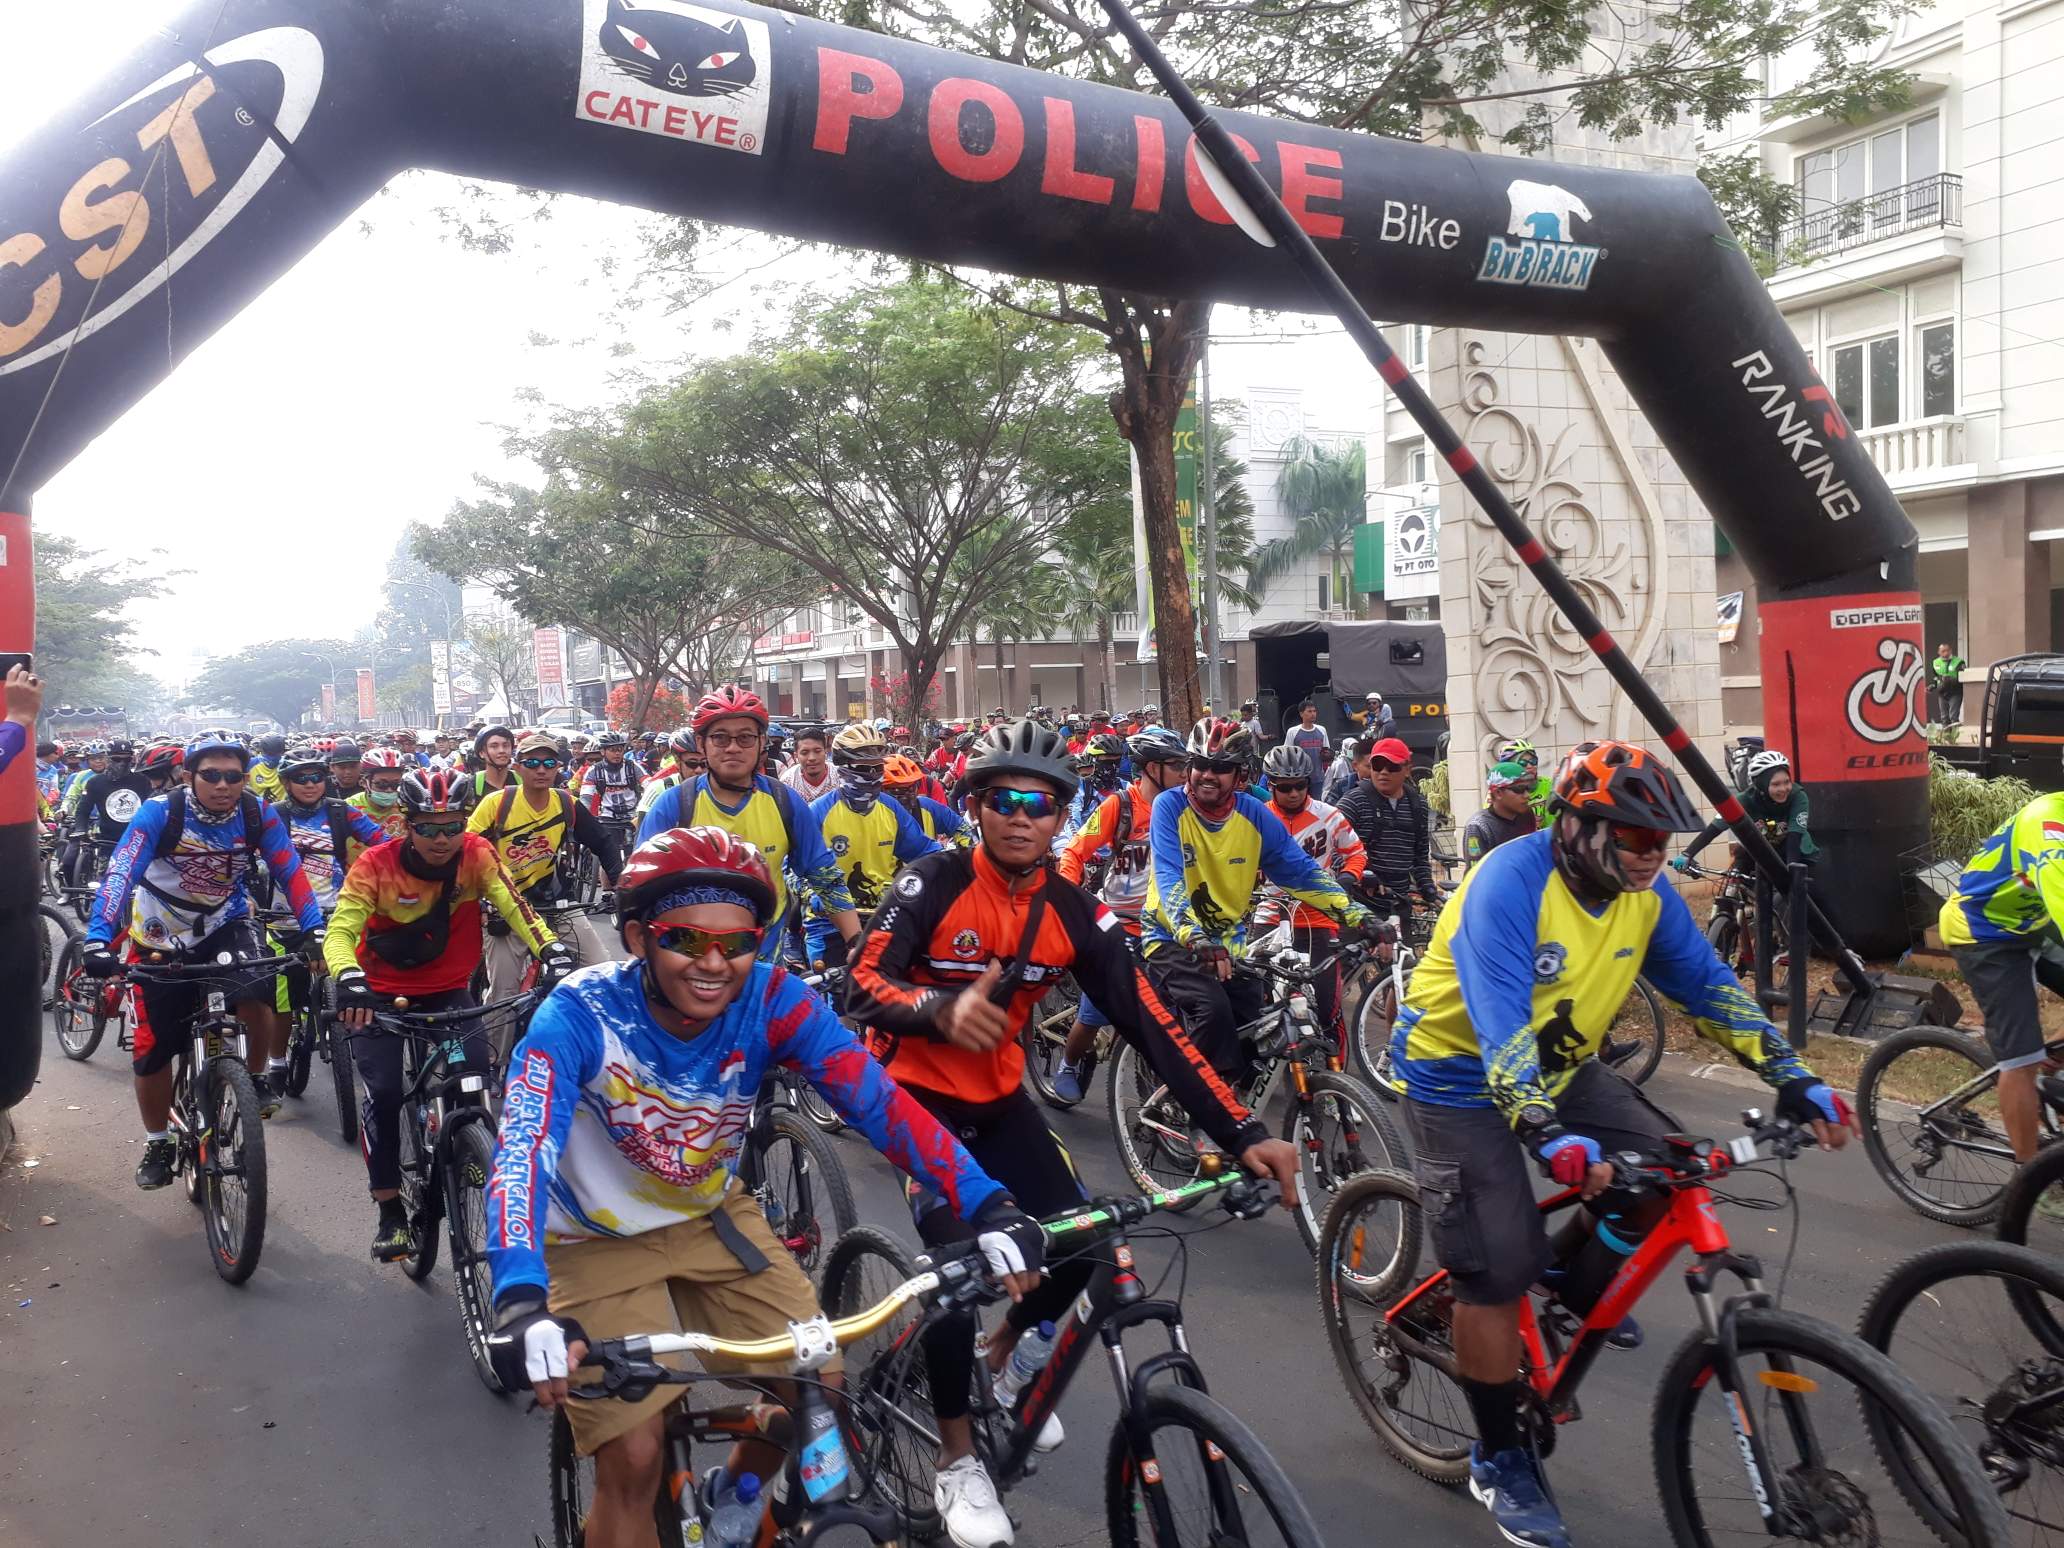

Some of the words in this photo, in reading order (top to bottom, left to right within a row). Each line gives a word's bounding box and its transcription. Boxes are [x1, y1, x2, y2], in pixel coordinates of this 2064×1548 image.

[584, 89, 739, 145] CATEYE
[812, 46, 1345, 240] POLICE
[0, 75, 217, 358] CST
[1379, 199, 1461, 250] Bike
[1732, 350, 1861, 521] RANKING
[1405, 562, 1415, 571] PT
[1417, 559, 1435, 569] OTO
